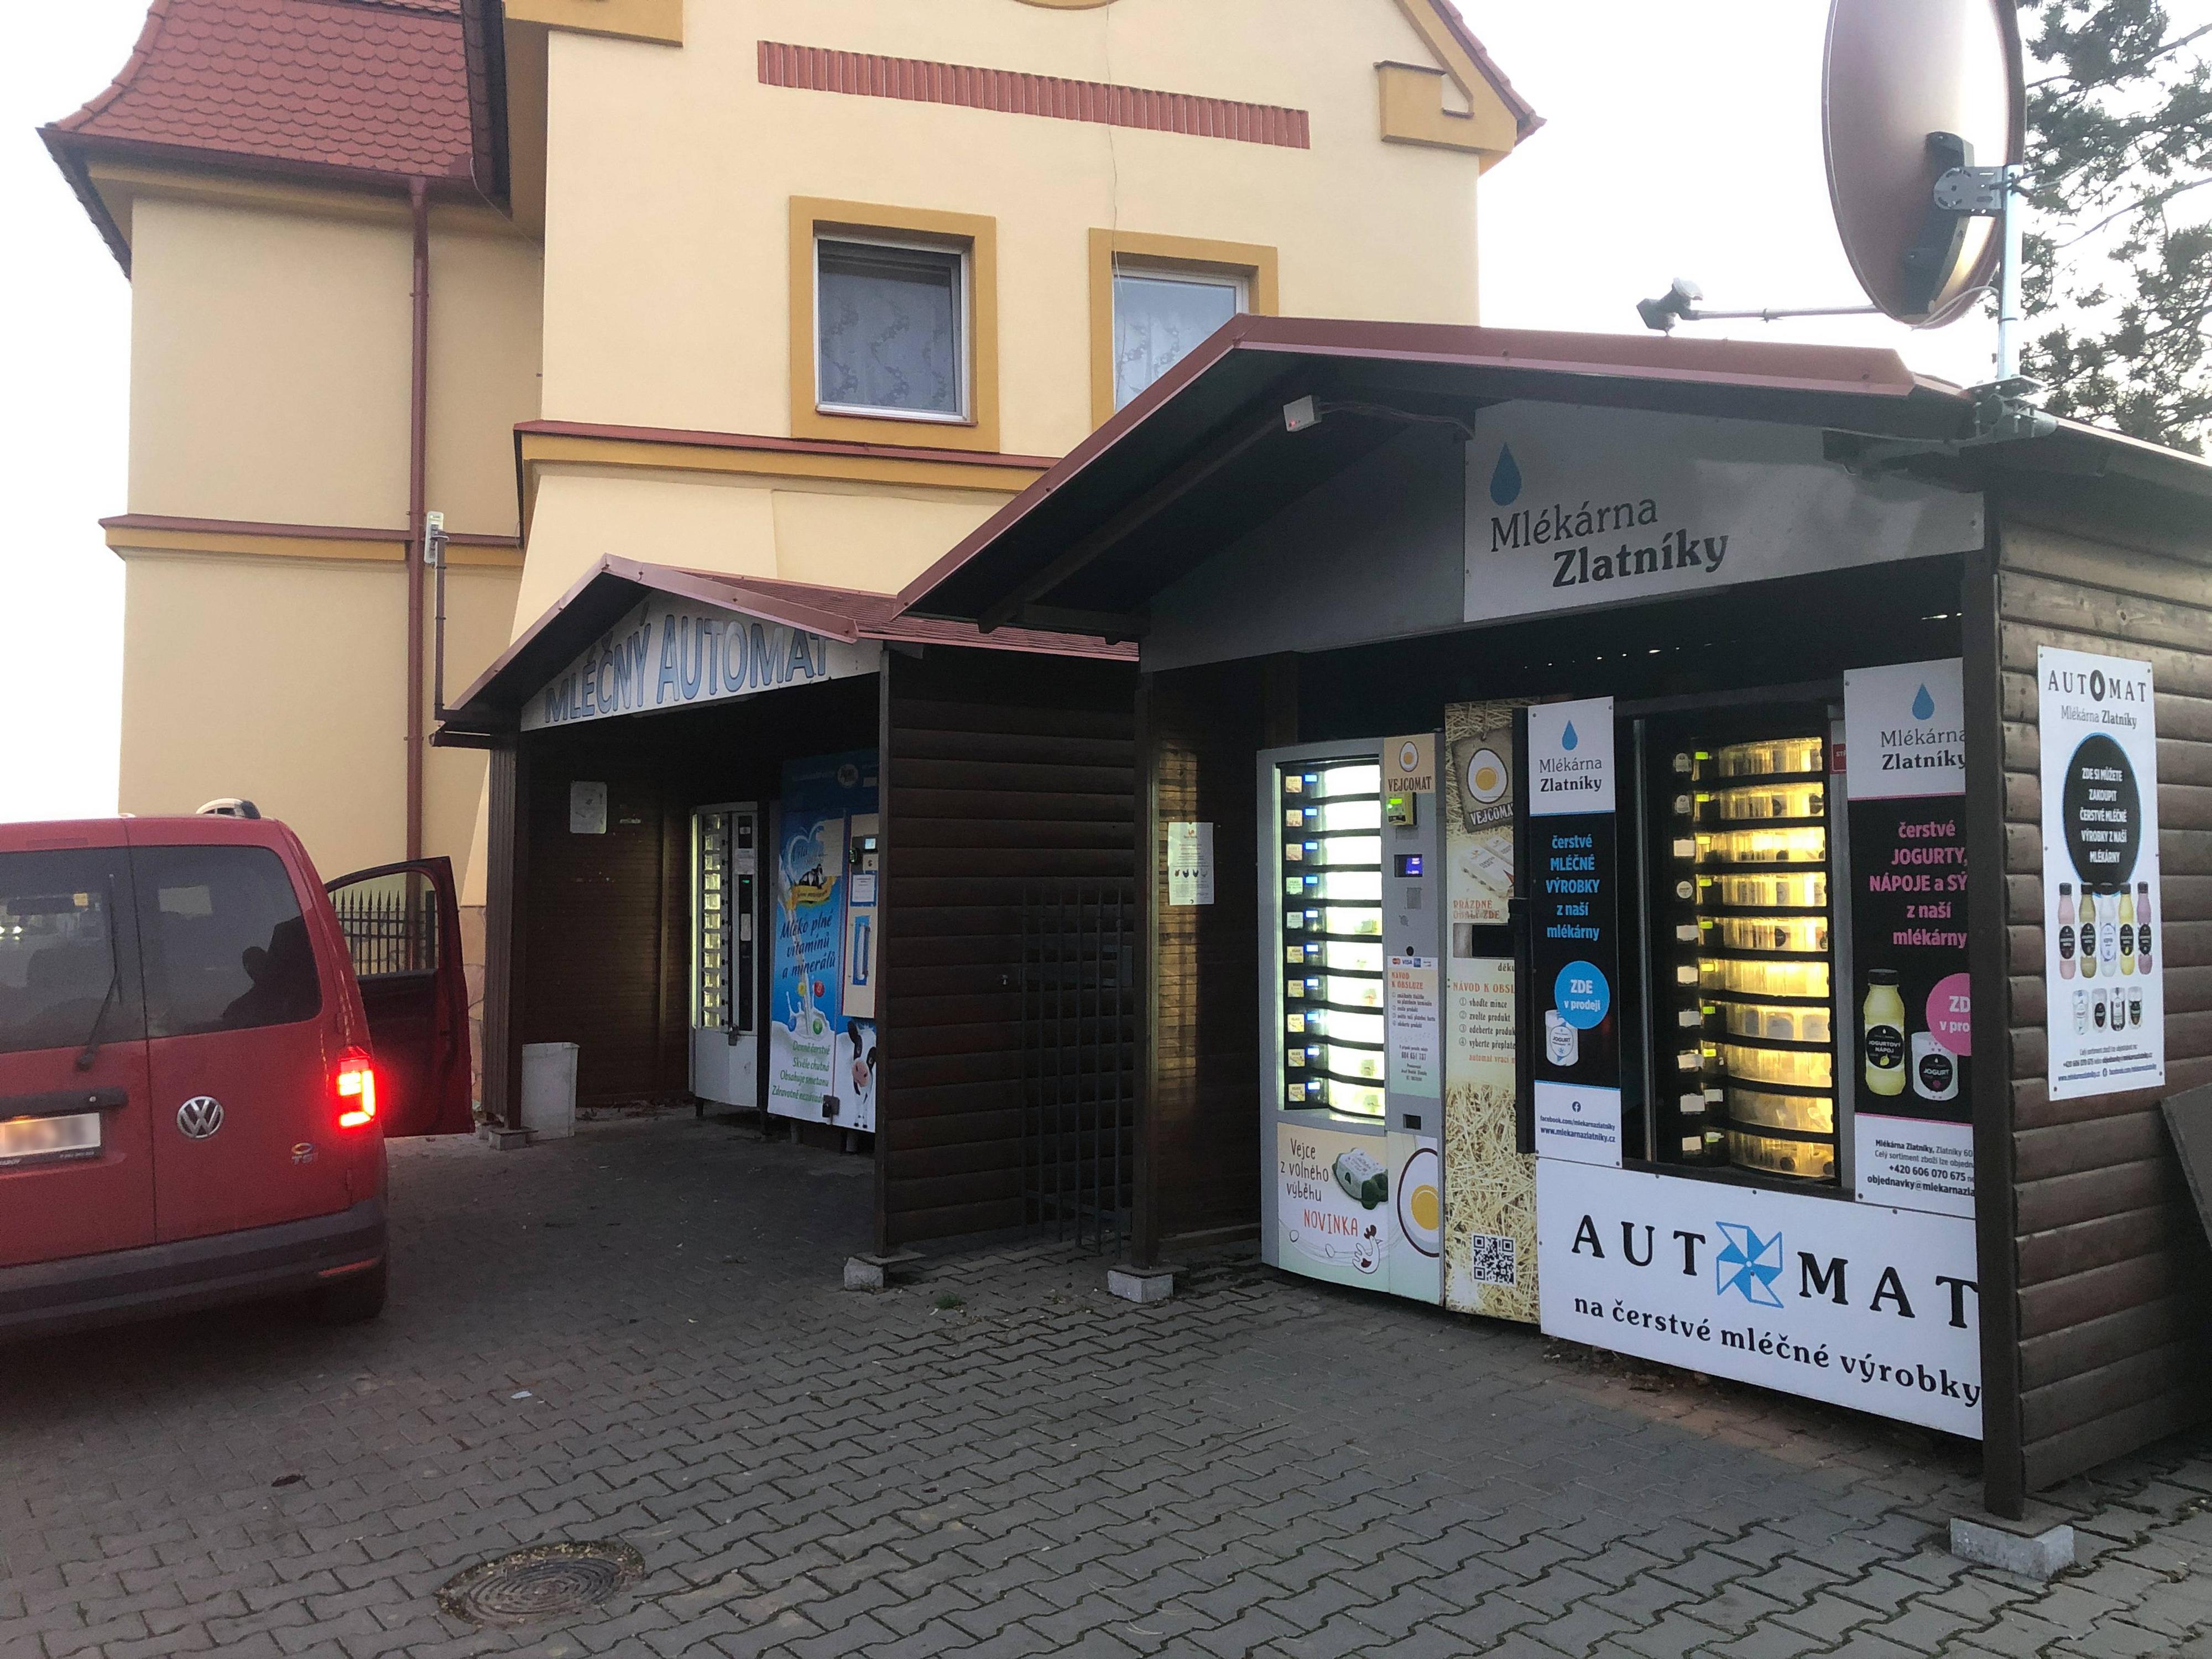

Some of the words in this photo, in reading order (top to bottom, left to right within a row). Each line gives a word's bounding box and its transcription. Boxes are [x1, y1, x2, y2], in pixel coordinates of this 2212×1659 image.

[1491, 499, 1658, 552] Mlékárna
[1552, 528, 1729, 587] Zlatníky
[544, 602, 651, 723] MLÉČNÝ
[656, 614, 830, 704] AUTOMAT
[2048, 669, 2147, 702] AUTOMAT
[2061, 705, 2099, 723] Mlékárna
[2101, 710, 2137, 729] Zlatníky
[1539, 756, 1602, 774] Mlékárna
[1882, 750, 1965, 770] Zlatníky
[2081, 767, 2094, 780] ZDE
[1387, 776, 1432, 792] VEJCOMAT
[1540, 776, 1602, 792] Zlatníky
[2089, 789, 2117, 801] ZAKOUPIT
[1470, 803, 1514, 826] VEJCOMA
[2080, 807, 2105, 822] ČERSTVÉ
[2105, 808, 2127, 822] MLÉČNÉ
[1898, 820, 1955, 839] čerstvé
[1552, 833, 1593, 849] čerstvé
[1550, 854, 1595, 871] MLÉČNÉ
[1891, 847, 1968, 866] JOGURTY,
[2090, 849, 2121, 863] MLÉKÁRNY
[1546, 876, 1600, 894] VÝROBKY
[1870, 872, 1931, 892] NÁPOJE
[1934, 878, 1944, 890] a
[1556, 906, 1563, 916] z
[1564, 902, 1589, 916] naší
[1906, 906, 1914, 919] z
[1918, 902, 1951, 920] naší
[780, 917, 808, 940] Mléko
[811, 911, 833, 936] plné
[1547, 924, 1600, 941] mlékárny
[787, 932, 831, 958] vitamínů
[1893, 929, 1967, 948] mlékárny
[782, 968, 789, 979] a
[791, 950, 836, 977] minerálů
[1453, 980, 1480, 992] NÁVOD
[1484, 983, 1489, 992] K
[1570, 979, 1593, 994] ZDE
[1490, 1000, 1507, 1008] mince
[1564, 1000, 1569, 1009] v
[1570, 998, 1600, 1013] prodeji
[1488, 1013, 1511, 1022] produkt
[1939, 1022, 1947, 1031] v
[1291, 1138, 1316, 1160] Vejce
[1875, 1139, 1905, 1149] Mlékárna
[1936, 1146, 1963, 1157] Zlatníky
[1875, 1150, 1887, 1159] Celý
[1889, 1152, 1919, 1162] sortiment
[1950, 1159, 1974, 1168] objedn
[1289, 1161, 1329, 1182] volného
[1890, 1164, 1910, 1174] +420
[1912, 1167, 1929, 1176] 606
[1932, 1170, 1948, 1179] 070
[1950, 1172, 1966, 1182] 675
[1286, 1181, 1322, 1202] výběhu
[1304, 1208, 1358, 1237] NOVINKA
[1574, 1296, 1604, 1318] na
[1612, 1298, 1712, 1342] čerstvé
[1721, 1326, 1830, 1368] mléčné
[1840, 1354, 1981, 1407] výrobky
